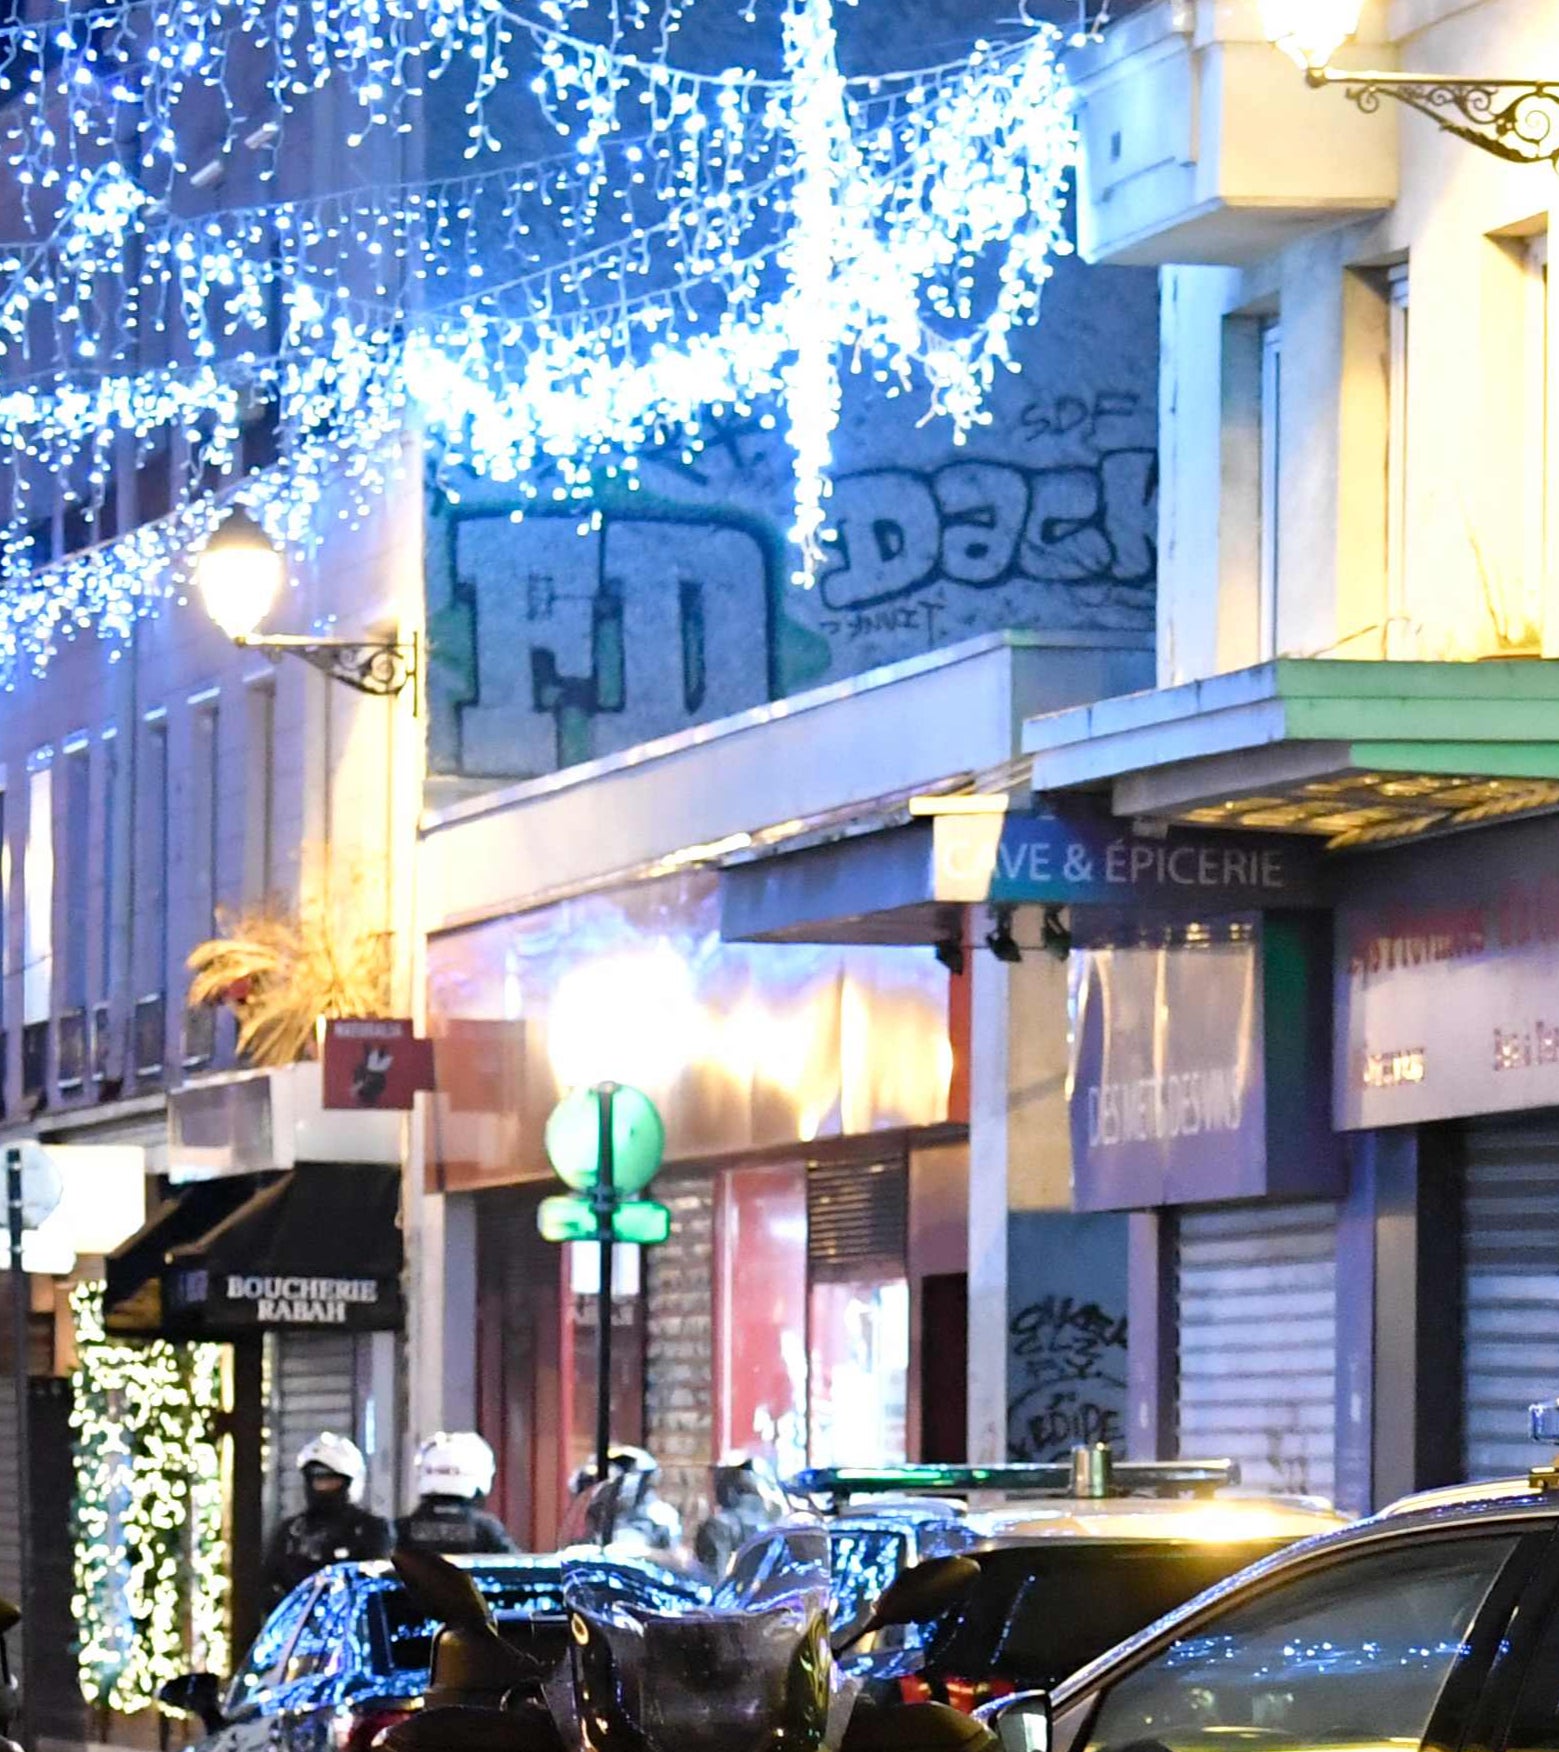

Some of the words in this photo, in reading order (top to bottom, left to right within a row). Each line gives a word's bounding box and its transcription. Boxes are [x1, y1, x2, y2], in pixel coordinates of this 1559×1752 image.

[944, 842, 1052, 881] CAVE
[1063, 843, 1093, 883] &
[1105, 839, 1286, 889] ÉPICERIE
[227, 1276, 378, 1302] BOUCHERIE
[257, 1300, 346, 1323] RABAH
